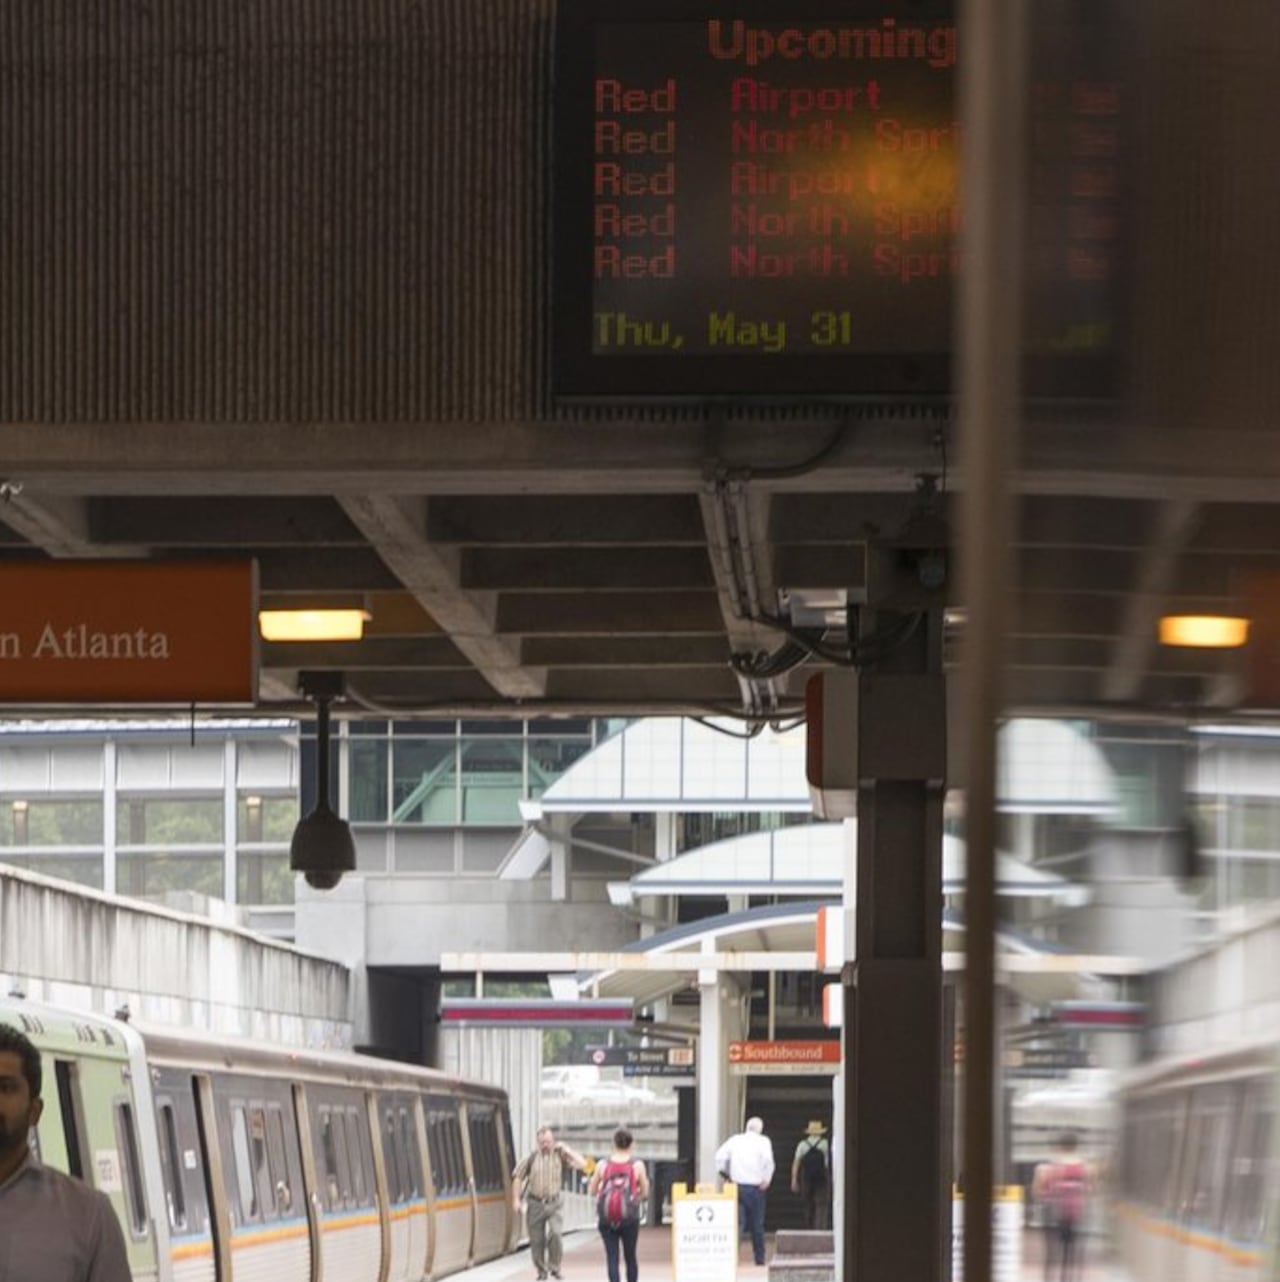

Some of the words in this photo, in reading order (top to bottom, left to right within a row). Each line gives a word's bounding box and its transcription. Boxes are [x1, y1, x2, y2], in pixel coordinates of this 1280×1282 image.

[707, 18, 958, 67] Upcoming
[594, 78, 676, 113] Red
[730, 77, 882, 117] Airport
[594, 120, 676, 155] Red
[730, 119, 850, 154] North
[874, 119, 965, 157] Spri
[594, 162, 676, 196] Red
[730, 161, 882, 199] Airport
[594, 203, 676, 238] Red
[730, 203, 850, 238] North
[873, 202, 965, 241] Spri
[594, 245, 676, 279] Red
[730, 244, 850, 279] North
[873, 244, 965, 283] Spri
[593, 312, 684, 349] Thu,
[708, 311, 786, 352] May
[810, 312, 852, 346] 31
[32, 622, 170, 660] Atlanta
[743, 1043, 823, 1060] Southbound
